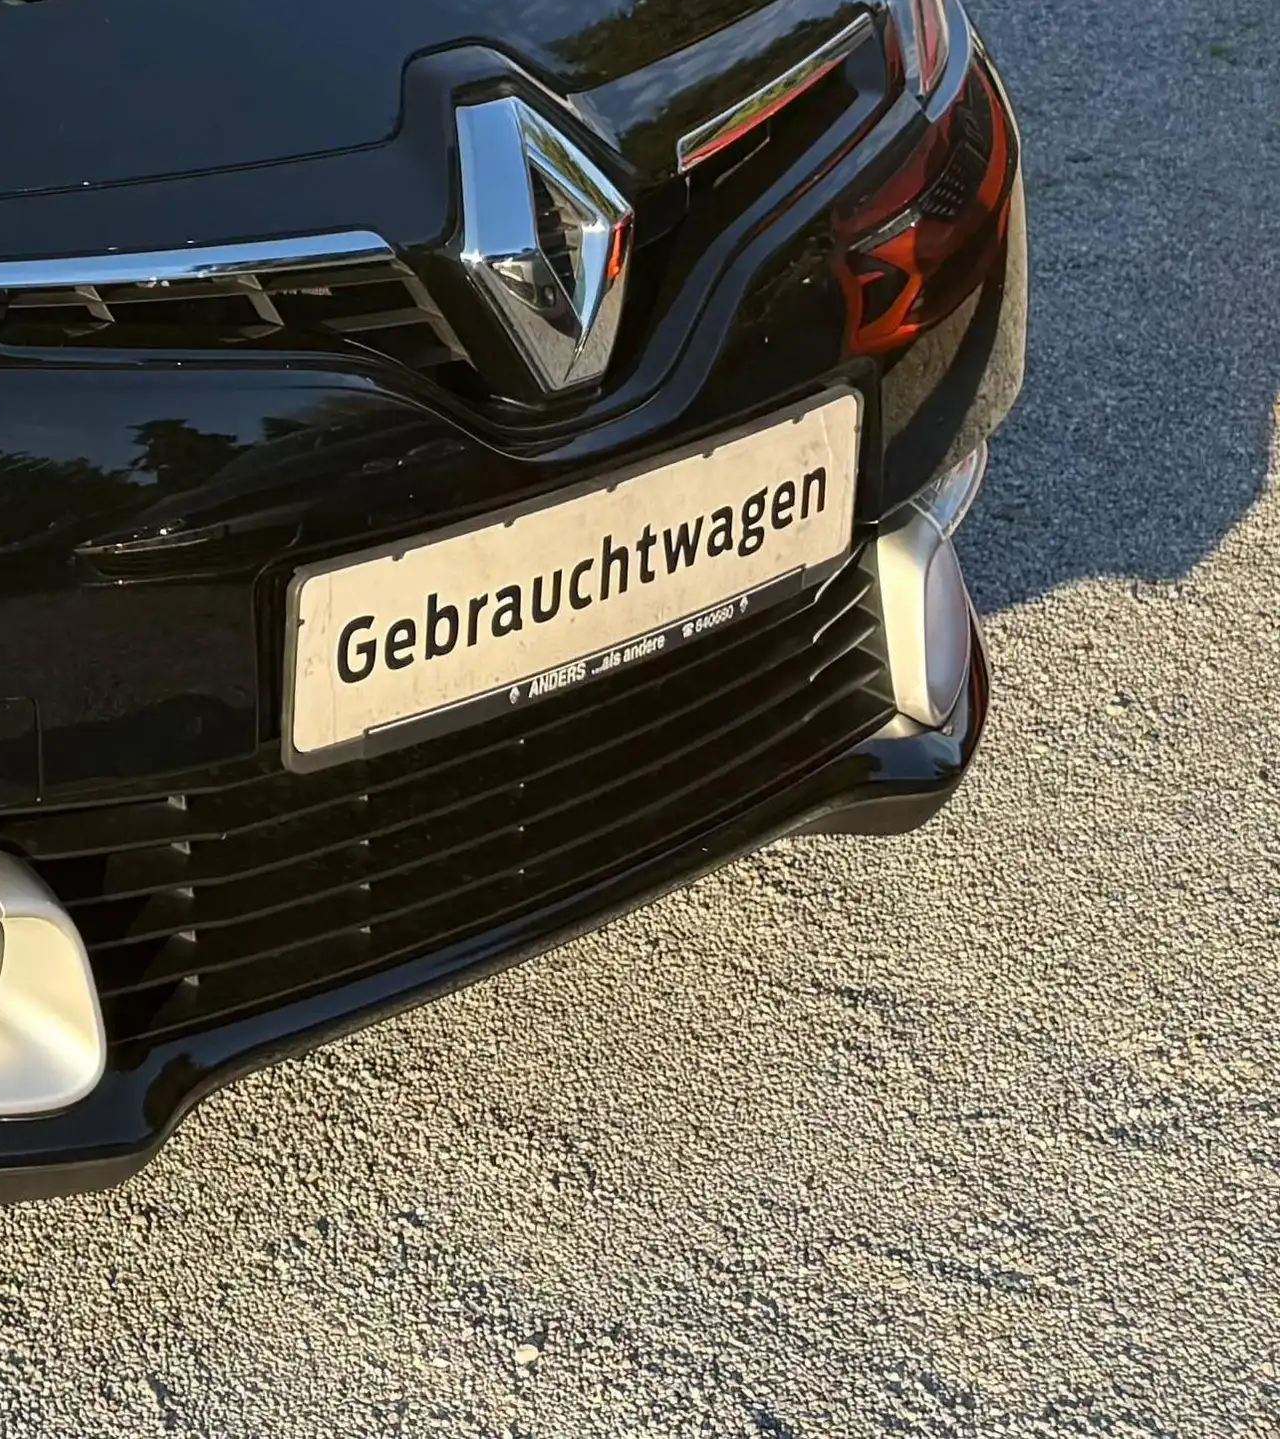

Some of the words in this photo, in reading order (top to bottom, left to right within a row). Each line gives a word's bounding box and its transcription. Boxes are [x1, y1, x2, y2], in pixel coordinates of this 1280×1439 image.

[336, 465, 828, 685] Gebrauchtwagen
[528, 661, 587, 699] ANDERS
[623, 634, 666, 661] andere
